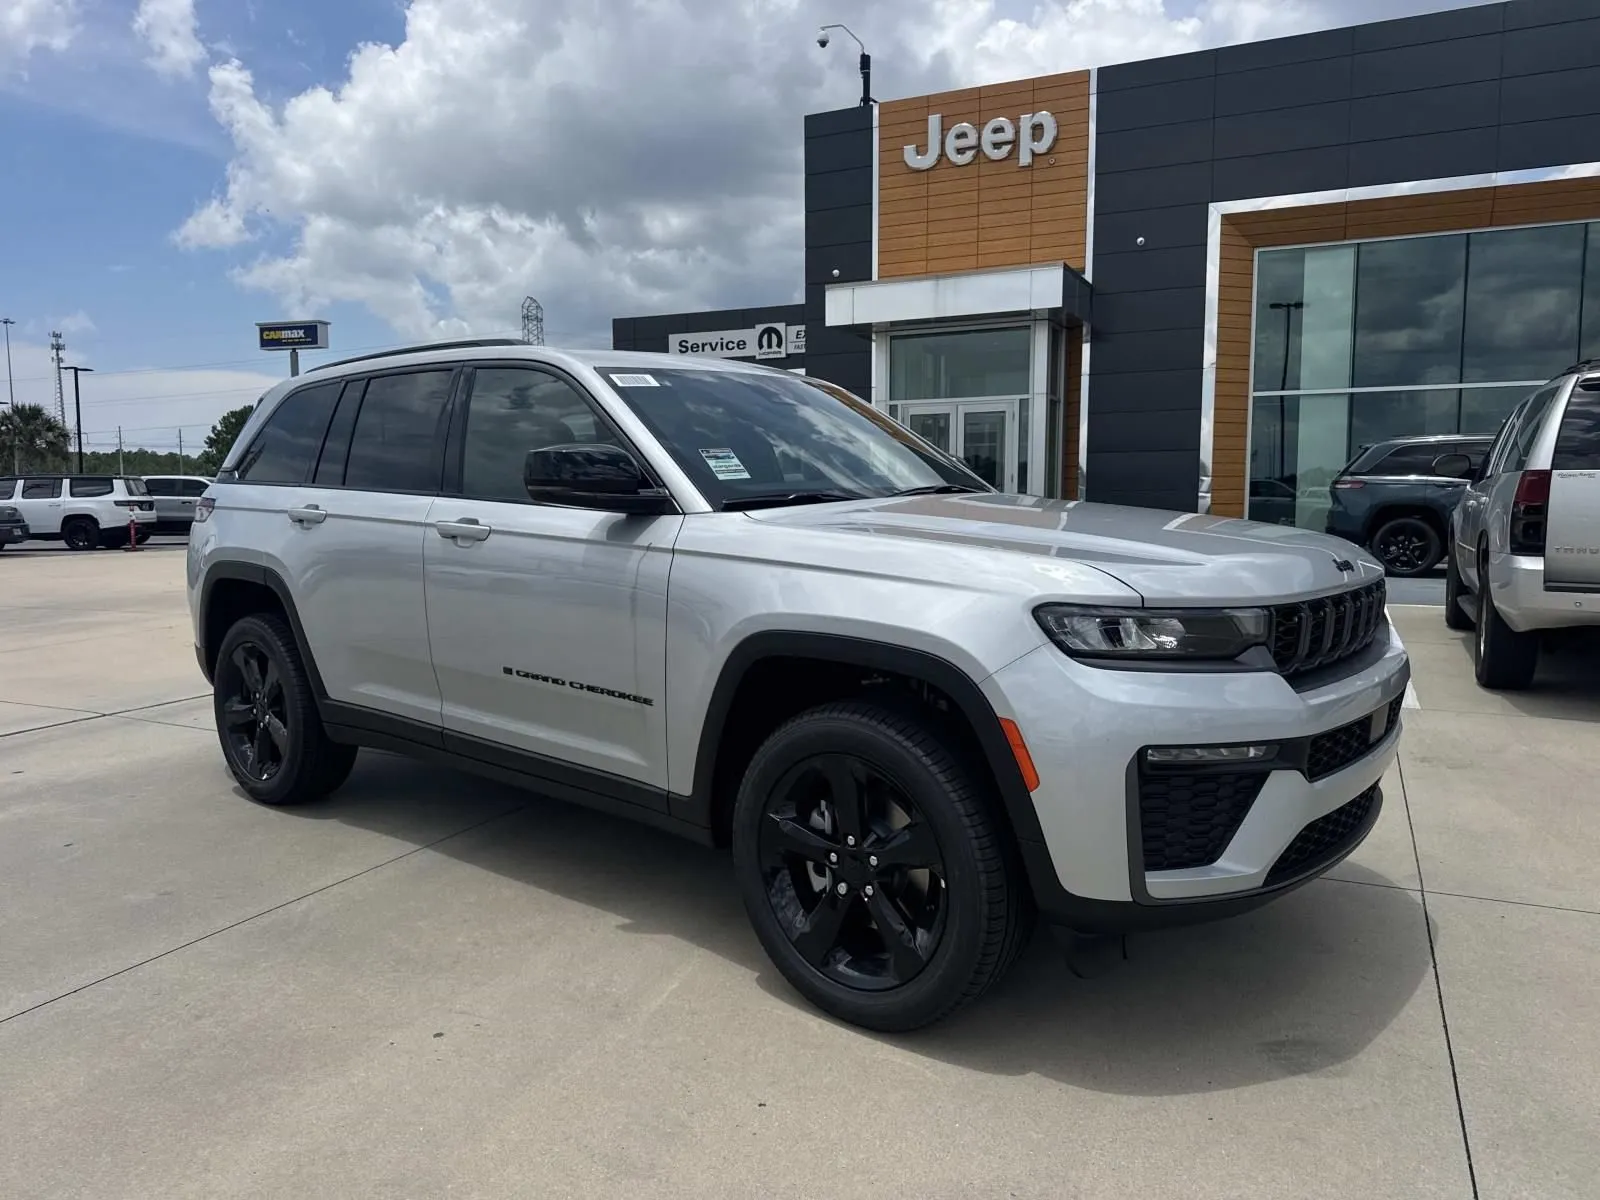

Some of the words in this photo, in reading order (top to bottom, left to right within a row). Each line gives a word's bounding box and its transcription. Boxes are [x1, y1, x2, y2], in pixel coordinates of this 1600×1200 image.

[903, 110, 1058, 171] Jeep
[678, 337, 747, 354] Service
[515, 669, 566, 686] GRAND
[568, 681, 654, 706] CHEROKEE
